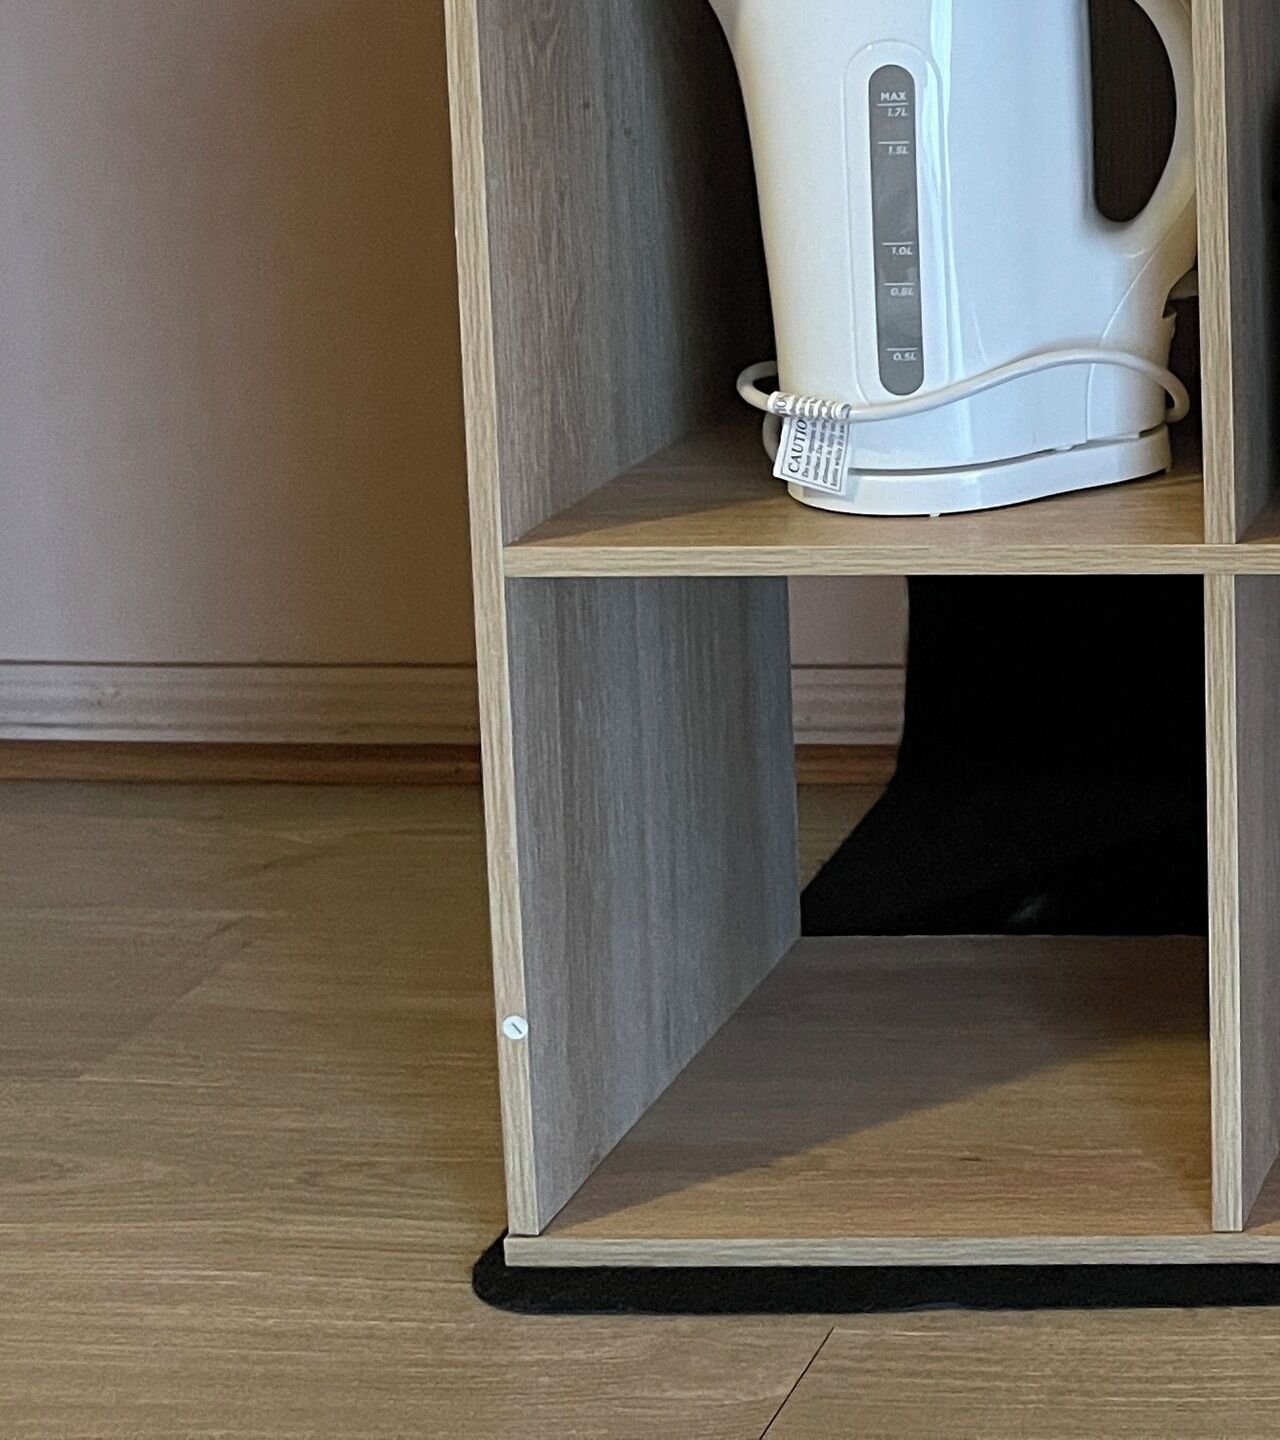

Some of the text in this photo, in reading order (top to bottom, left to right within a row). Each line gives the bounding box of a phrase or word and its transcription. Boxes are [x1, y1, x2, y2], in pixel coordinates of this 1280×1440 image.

[881, 92, 907, 101] MAX
[887, 108, 908, 117] 1.7L
[888, 145, 909, 154] 1.5L
[892, 246, 913, 255] 1.0L
[893, 351, 917, 361] 0.5L
[788, 419, 808, 473] CAUTIO
